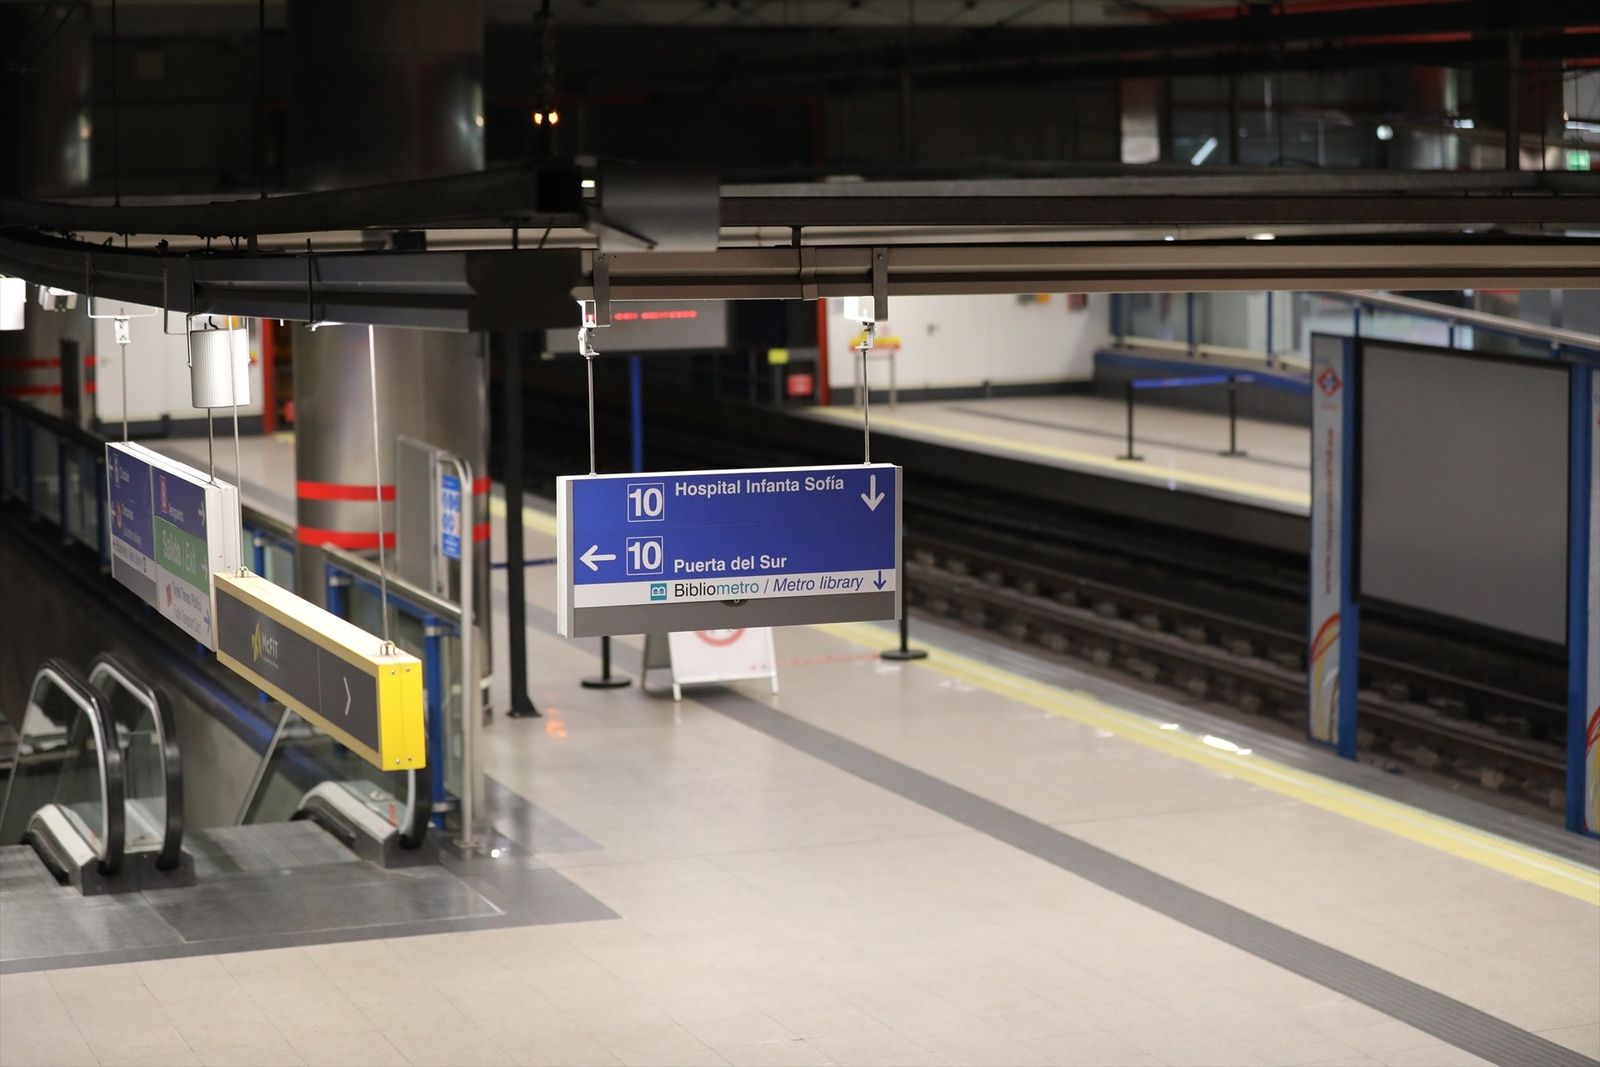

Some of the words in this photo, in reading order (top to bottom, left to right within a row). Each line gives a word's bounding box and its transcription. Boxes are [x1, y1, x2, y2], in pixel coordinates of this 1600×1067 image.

[675, 480, 741, 498] Hospital
[746, 478, 800, 493] Infanta
[804, 476, 844, 491] Sofía
[629, 488, 663, 517] 10
[628, 541, 662, 570] 10
[674, 558, 726, 573] Puerta
[730, 555, 755, 571] del
[760, 554, 787, 569] Sur
[674, 581, 760, 597] Bibliometro
[763, 578, 769, 594] /
[773, 578, 815, 592] Metro
[820, 575, 864, 591] library
